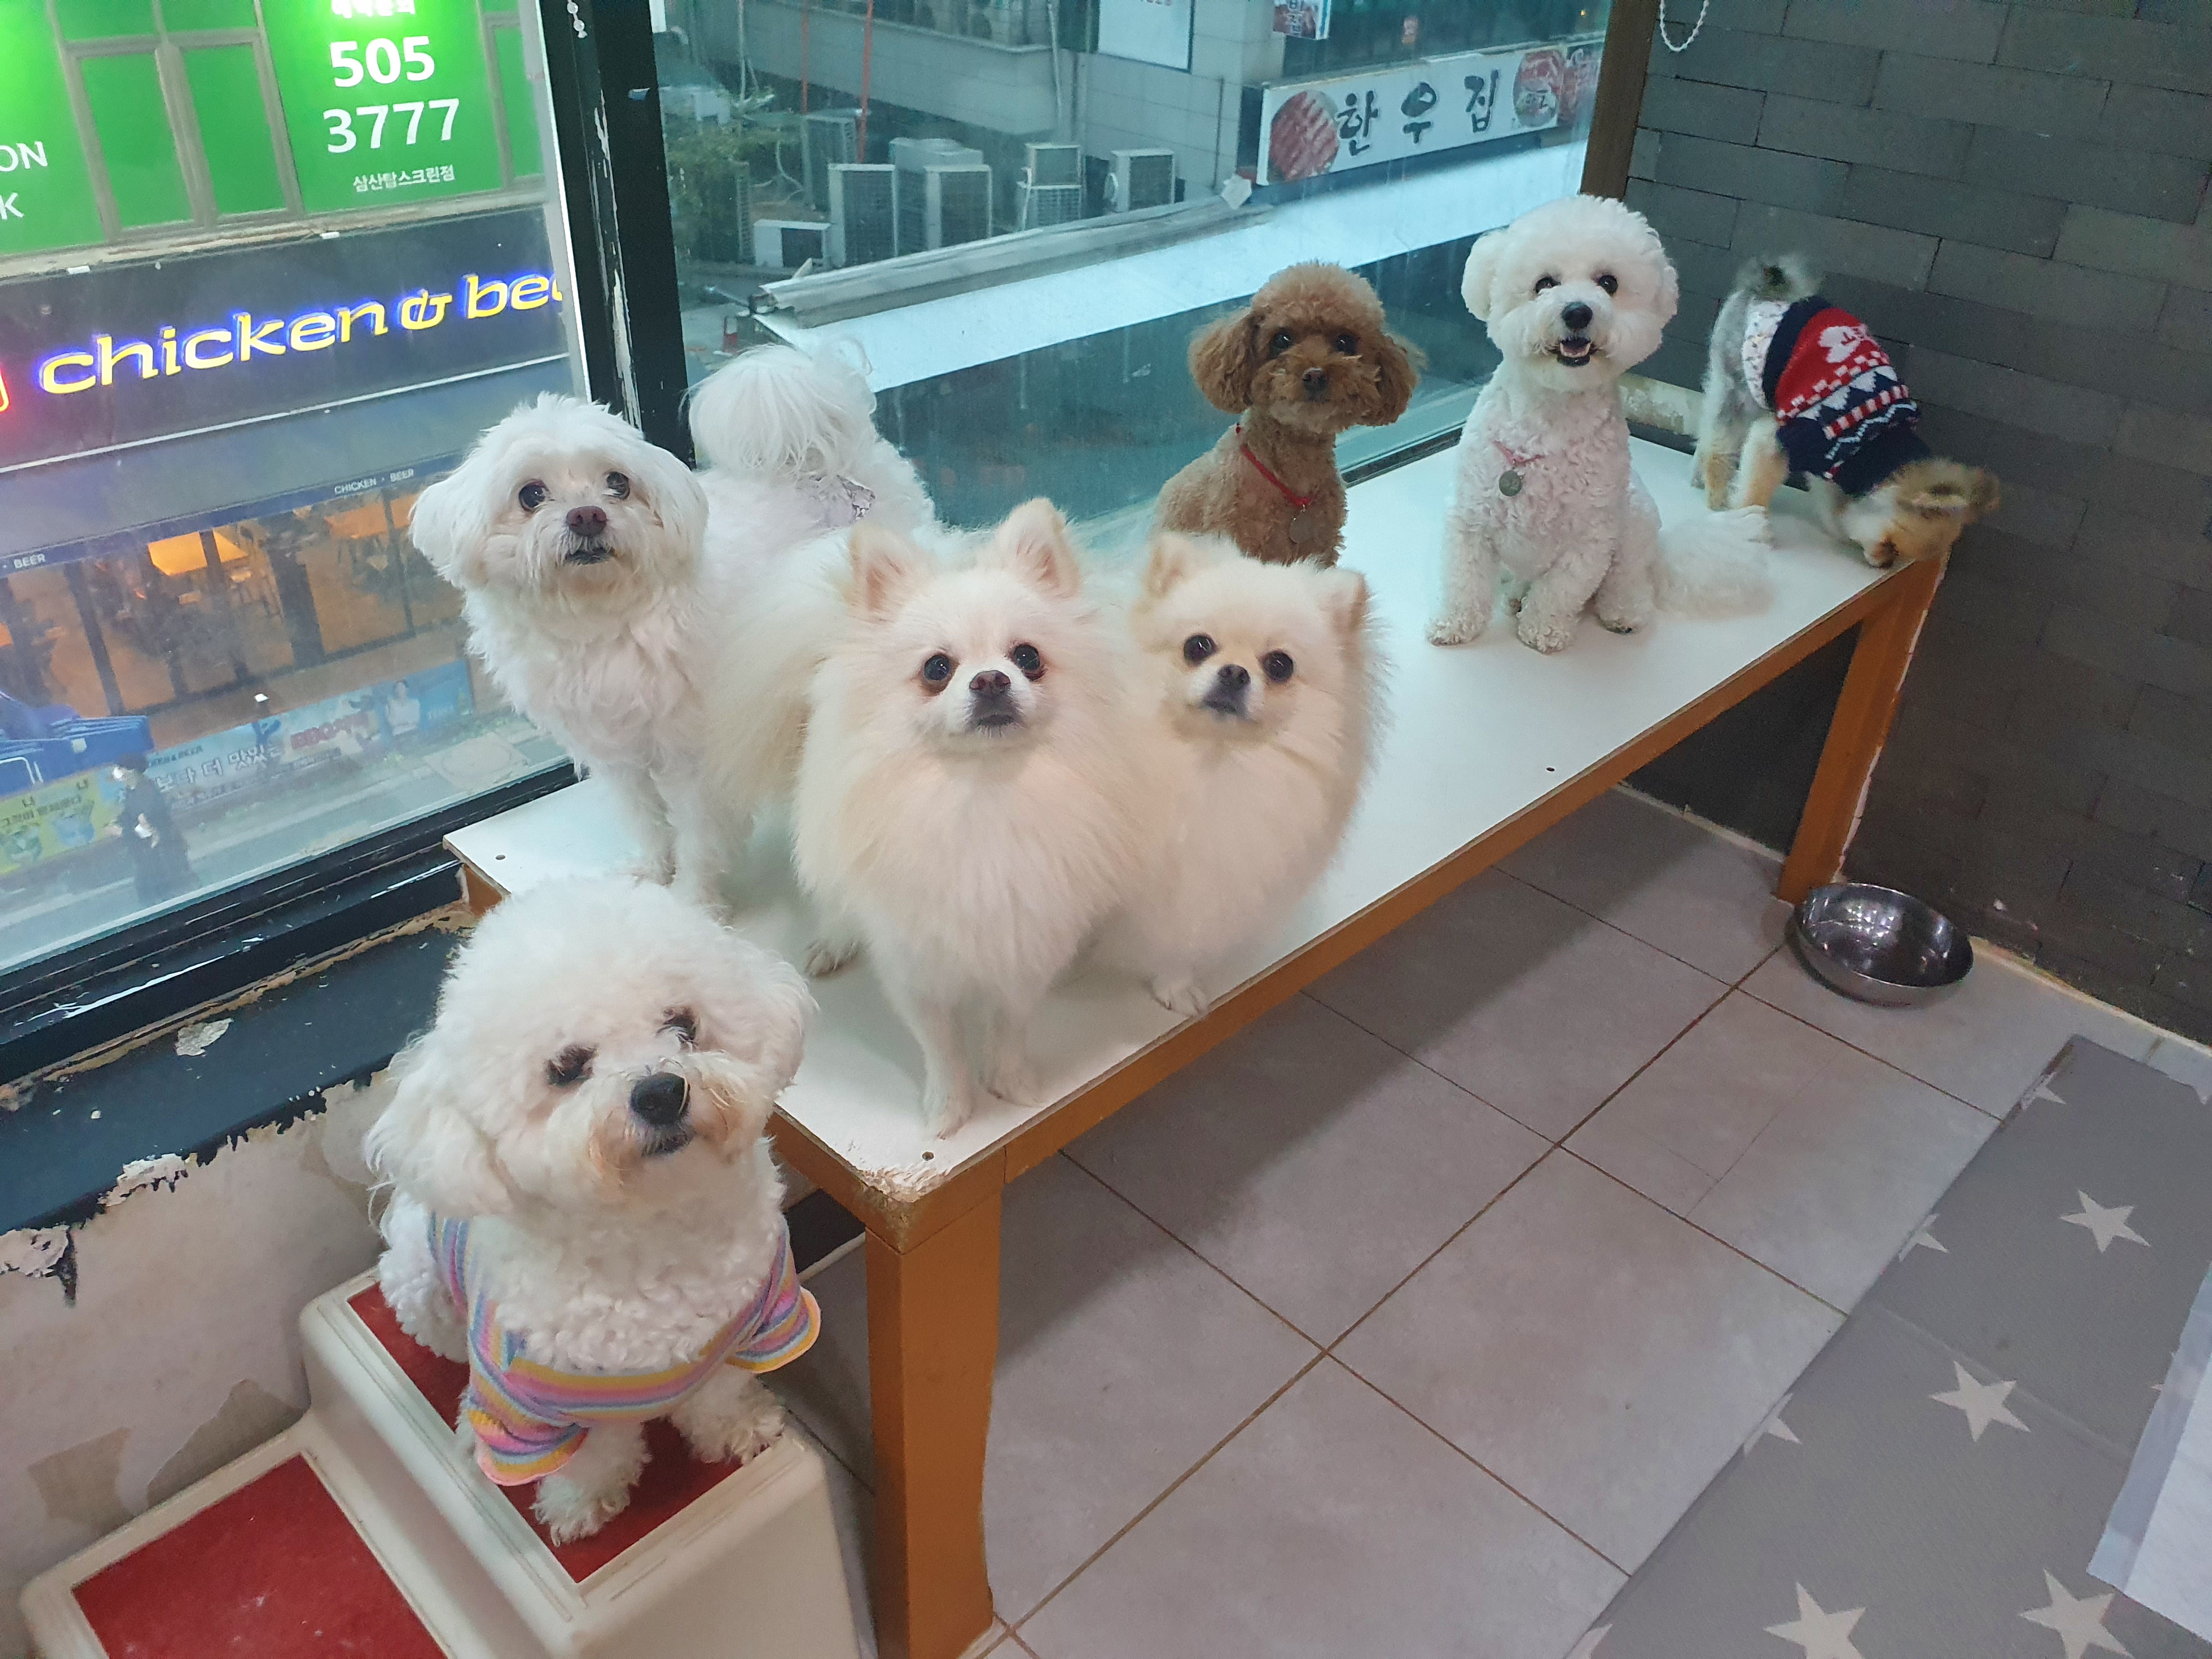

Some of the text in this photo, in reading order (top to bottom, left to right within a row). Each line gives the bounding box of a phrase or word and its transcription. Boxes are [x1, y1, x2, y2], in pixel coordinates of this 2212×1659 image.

[329, 36, 435, 87] 505
[323, 98, 460, 153] 3777
[40, 313, 388, 394] chicken
[400, 290, 452, 330] &
[334, 469, 414, 495] CHICKEN BEER
[14, 553, 46, 569] BEER
